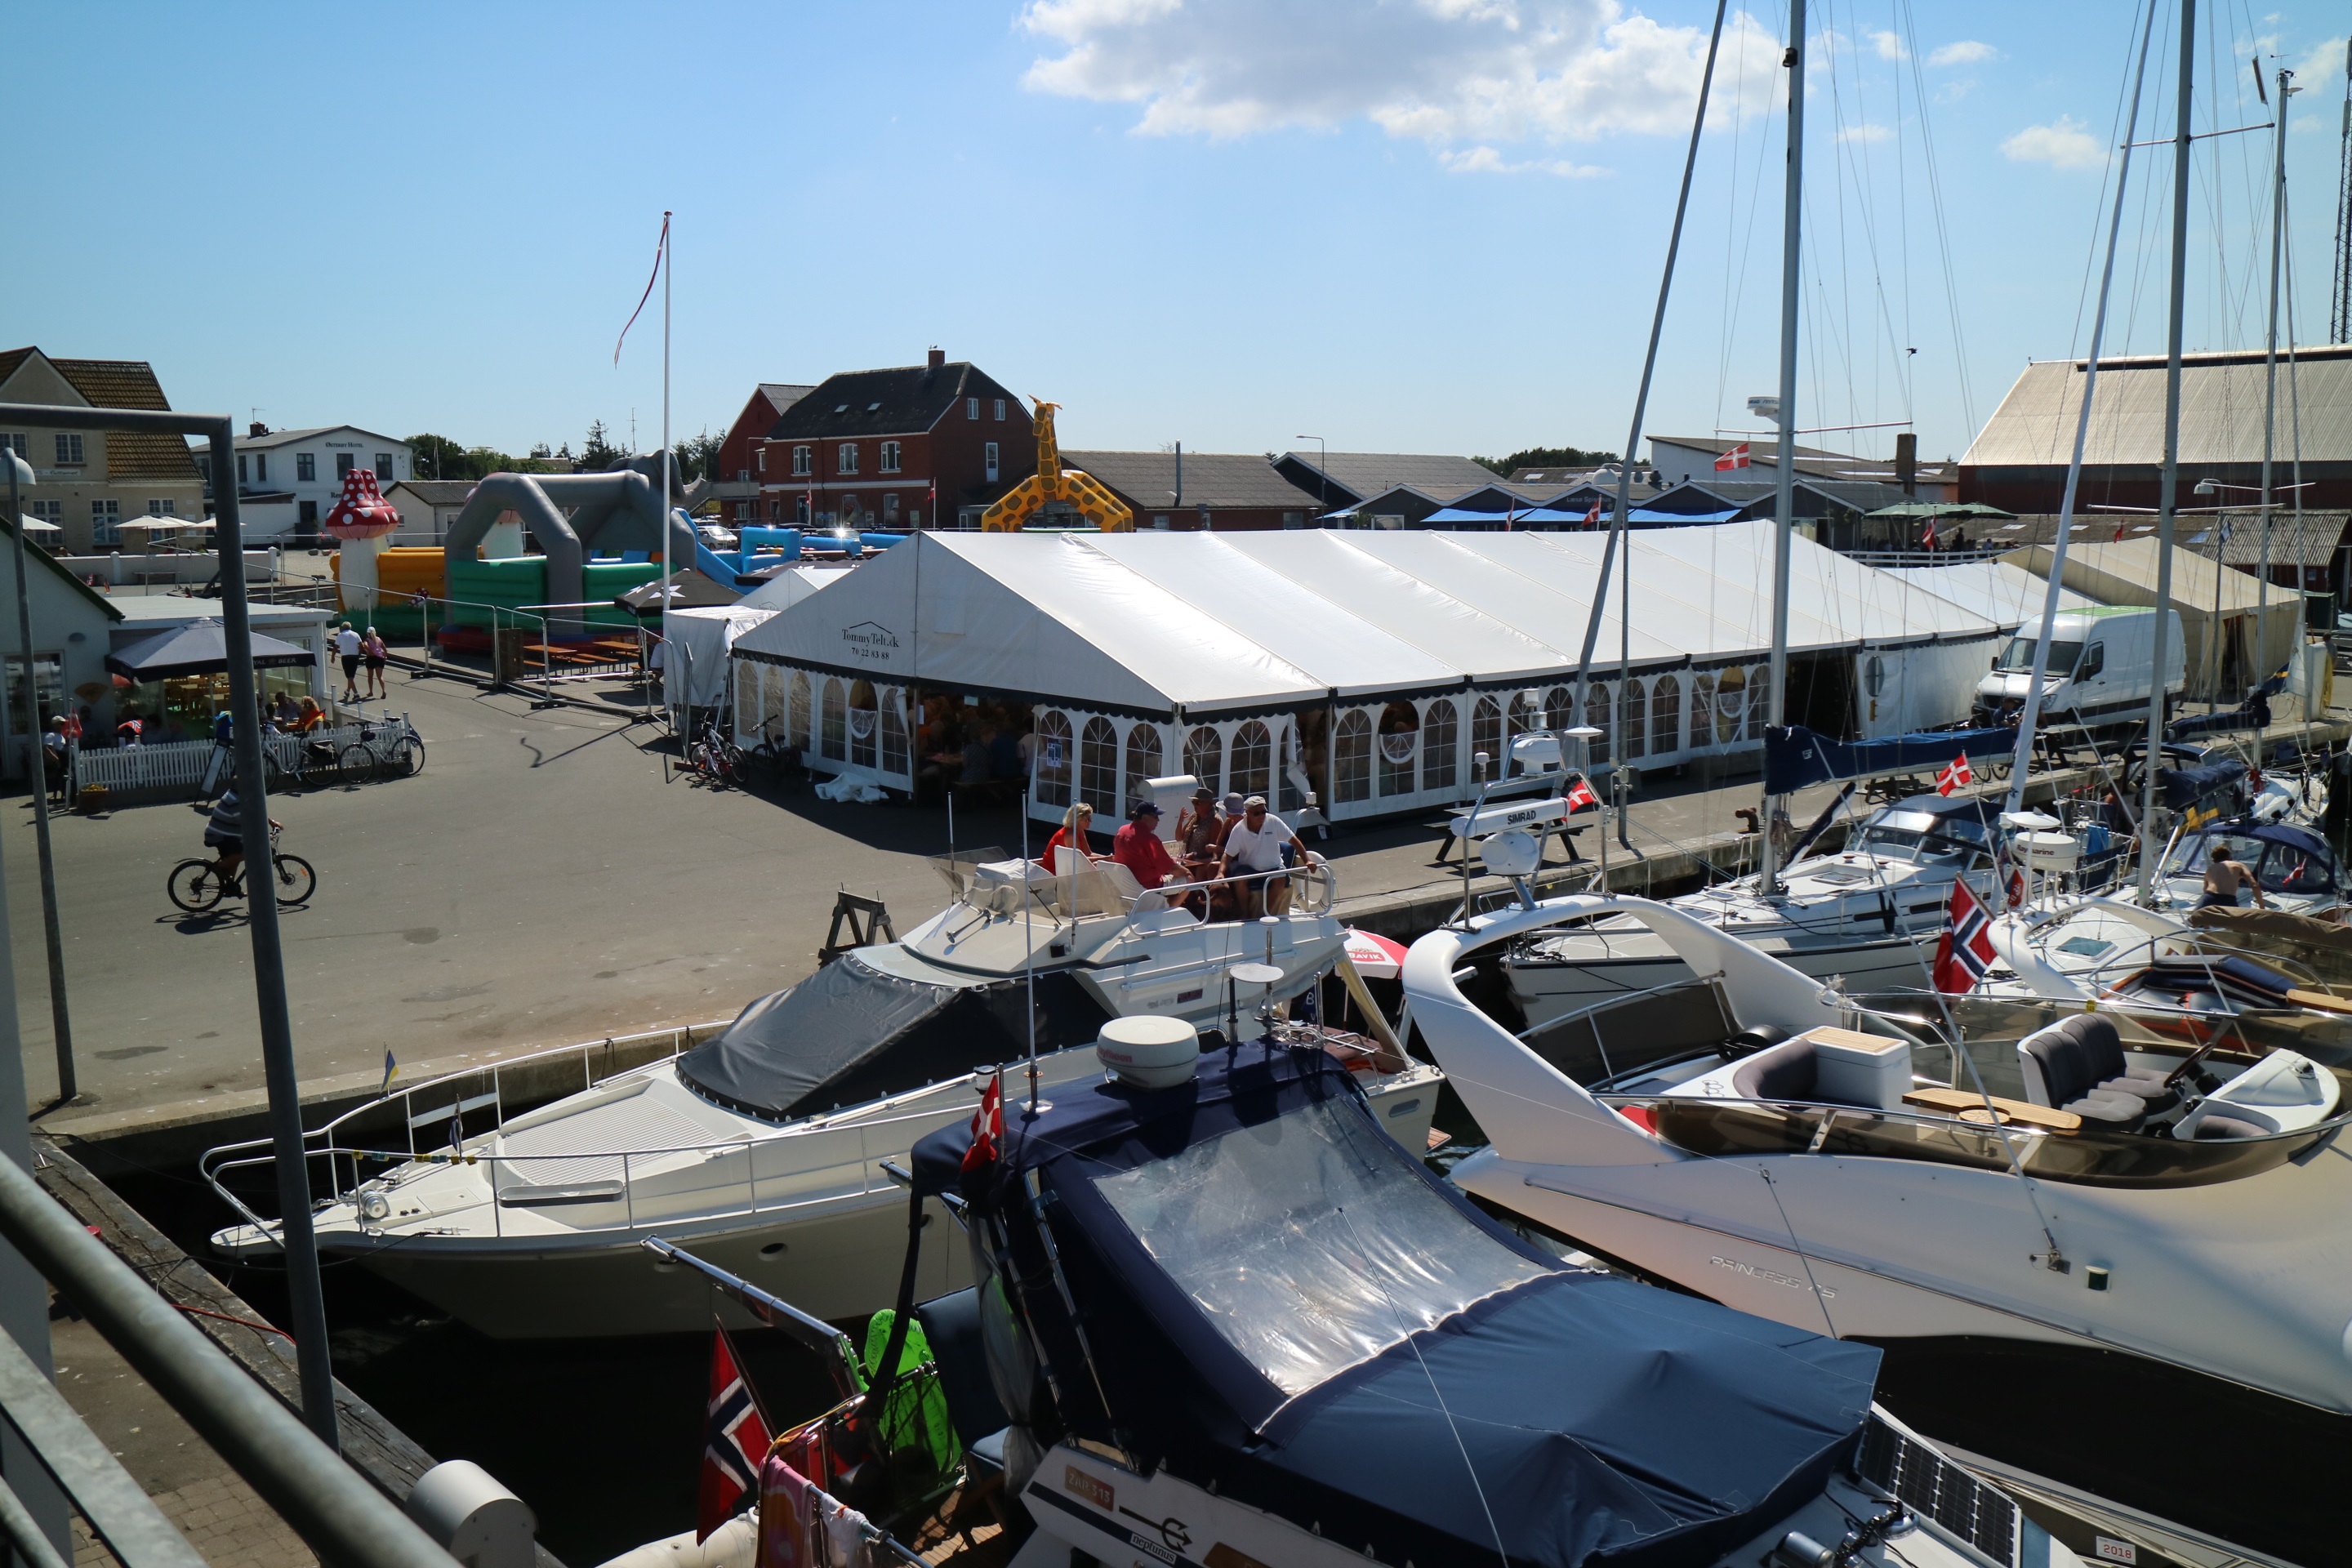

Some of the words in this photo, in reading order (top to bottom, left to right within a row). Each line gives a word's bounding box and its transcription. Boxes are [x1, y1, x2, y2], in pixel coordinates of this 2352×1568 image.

[842, 629, 899, 648] TommyTelt.dk
[852, 647, 859, 655] 70
[862, 648, 869, 657] 22
[871, 650, 880, 659] 83
[881, 652, 889, 660] 88
[1508, 809, 1536, 825] SIMRAD
[1348, 952, 1383, 960] BAVIK
[1710, 1255, 1802, 1289] PRINCESS
[1091, 1484, 1111, 1503] 313
[1132, 1535, 1175, 1562] neptunus
[2104, 1544, 2132, 1559] 2018
